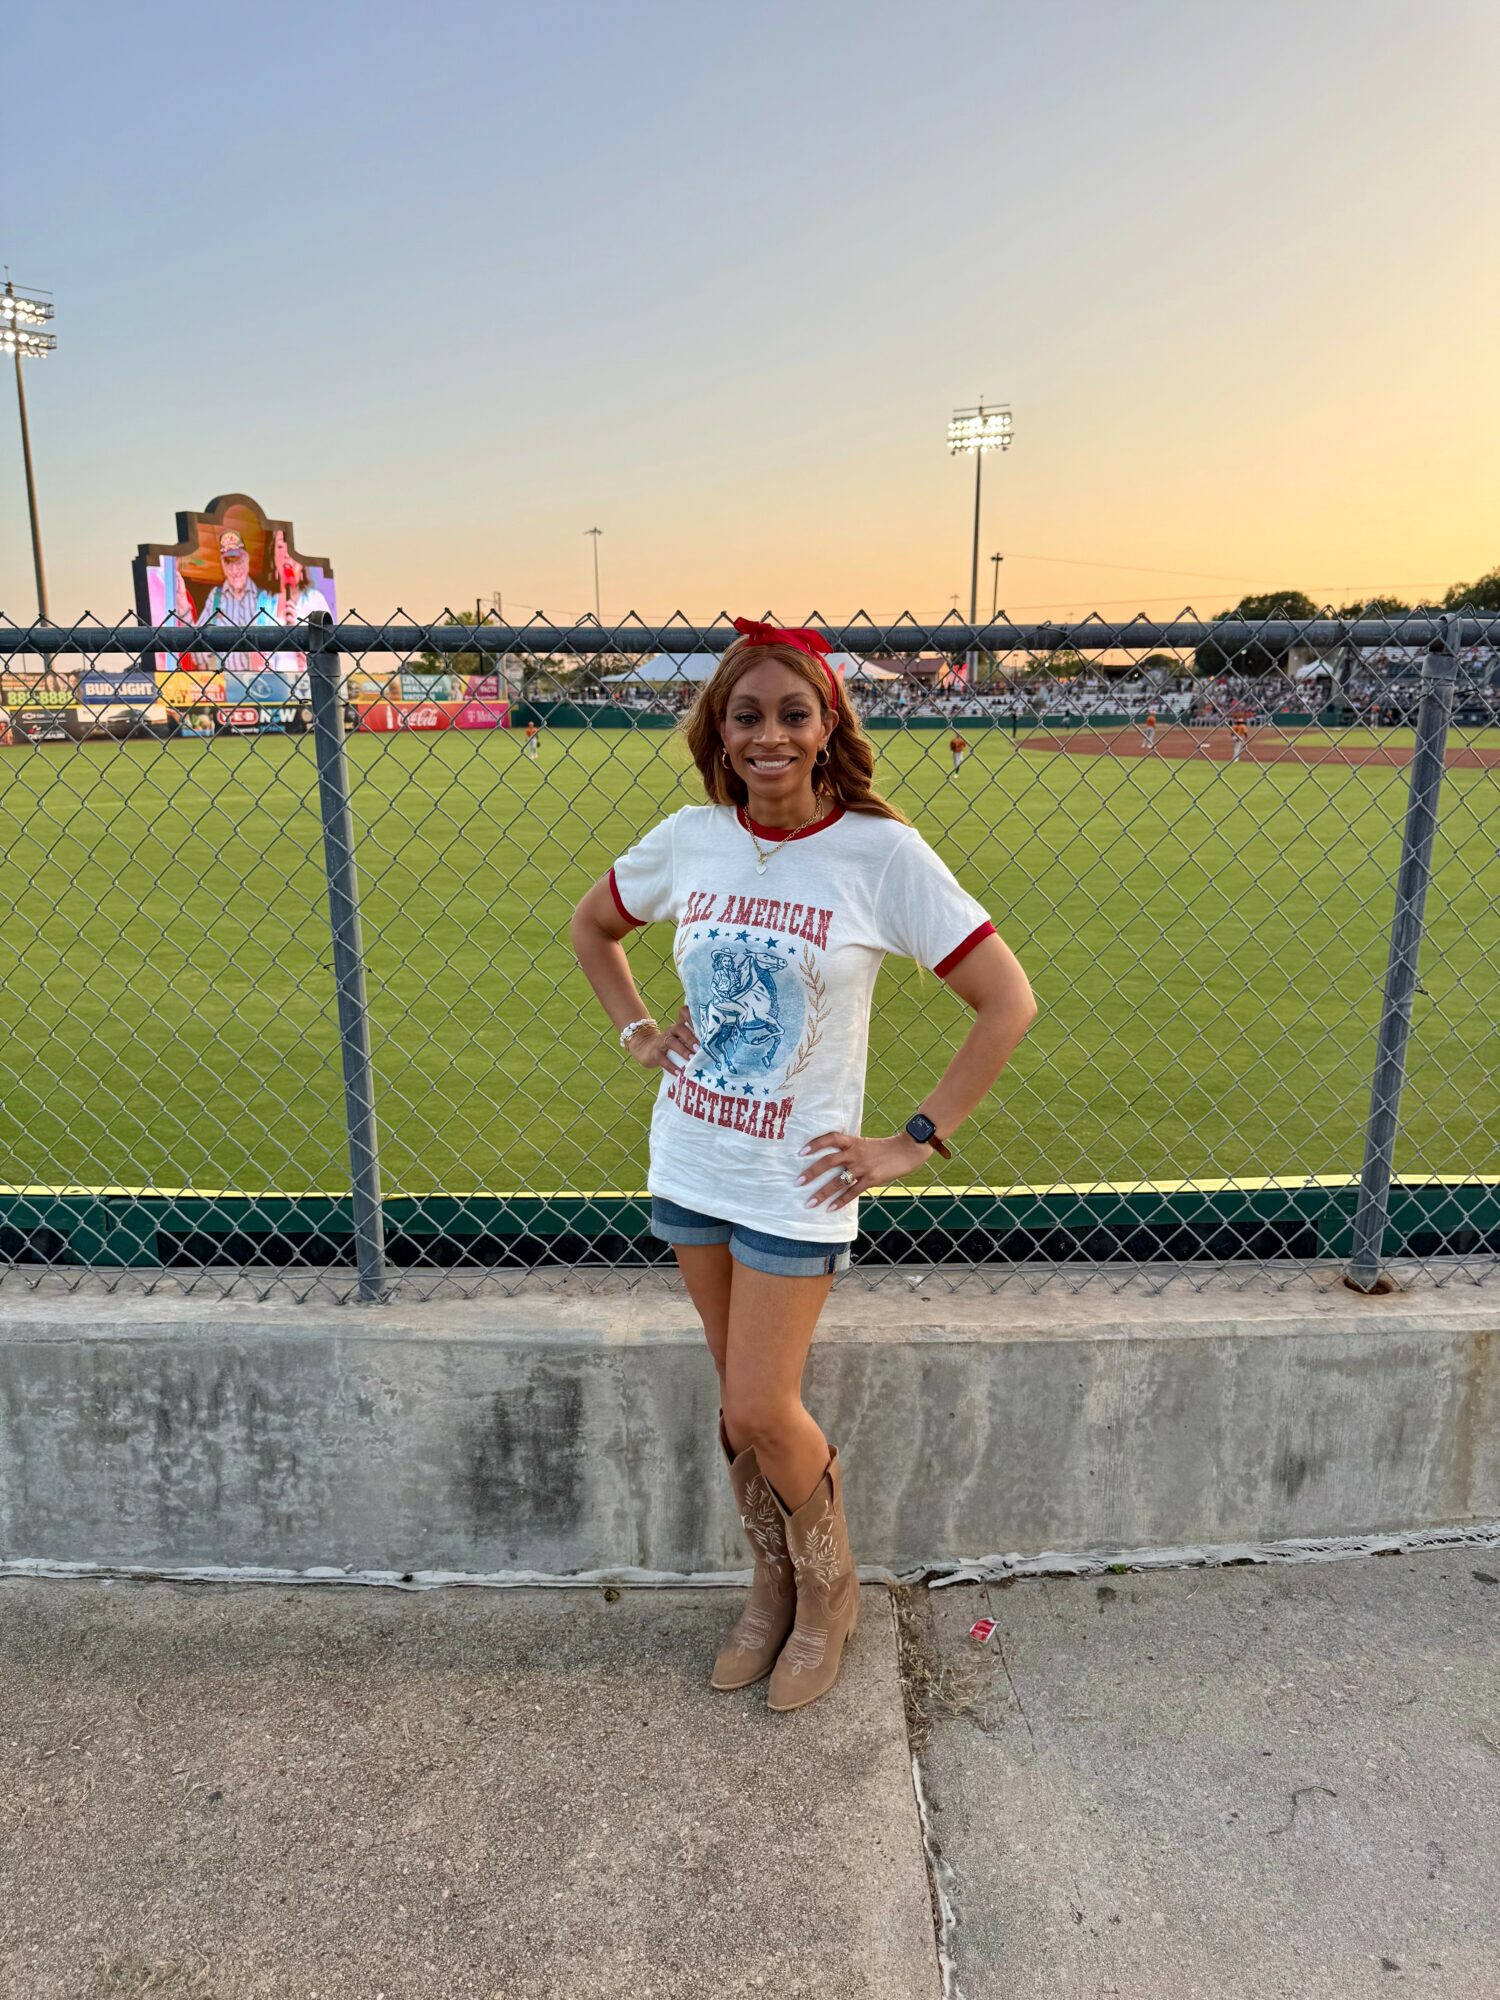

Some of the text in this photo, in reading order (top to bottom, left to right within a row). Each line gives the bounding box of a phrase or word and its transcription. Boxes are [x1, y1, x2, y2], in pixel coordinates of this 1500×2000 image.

[85, 683, 115, 696] BUD
[681, 891, 833, 952] ALL AMERICAN
